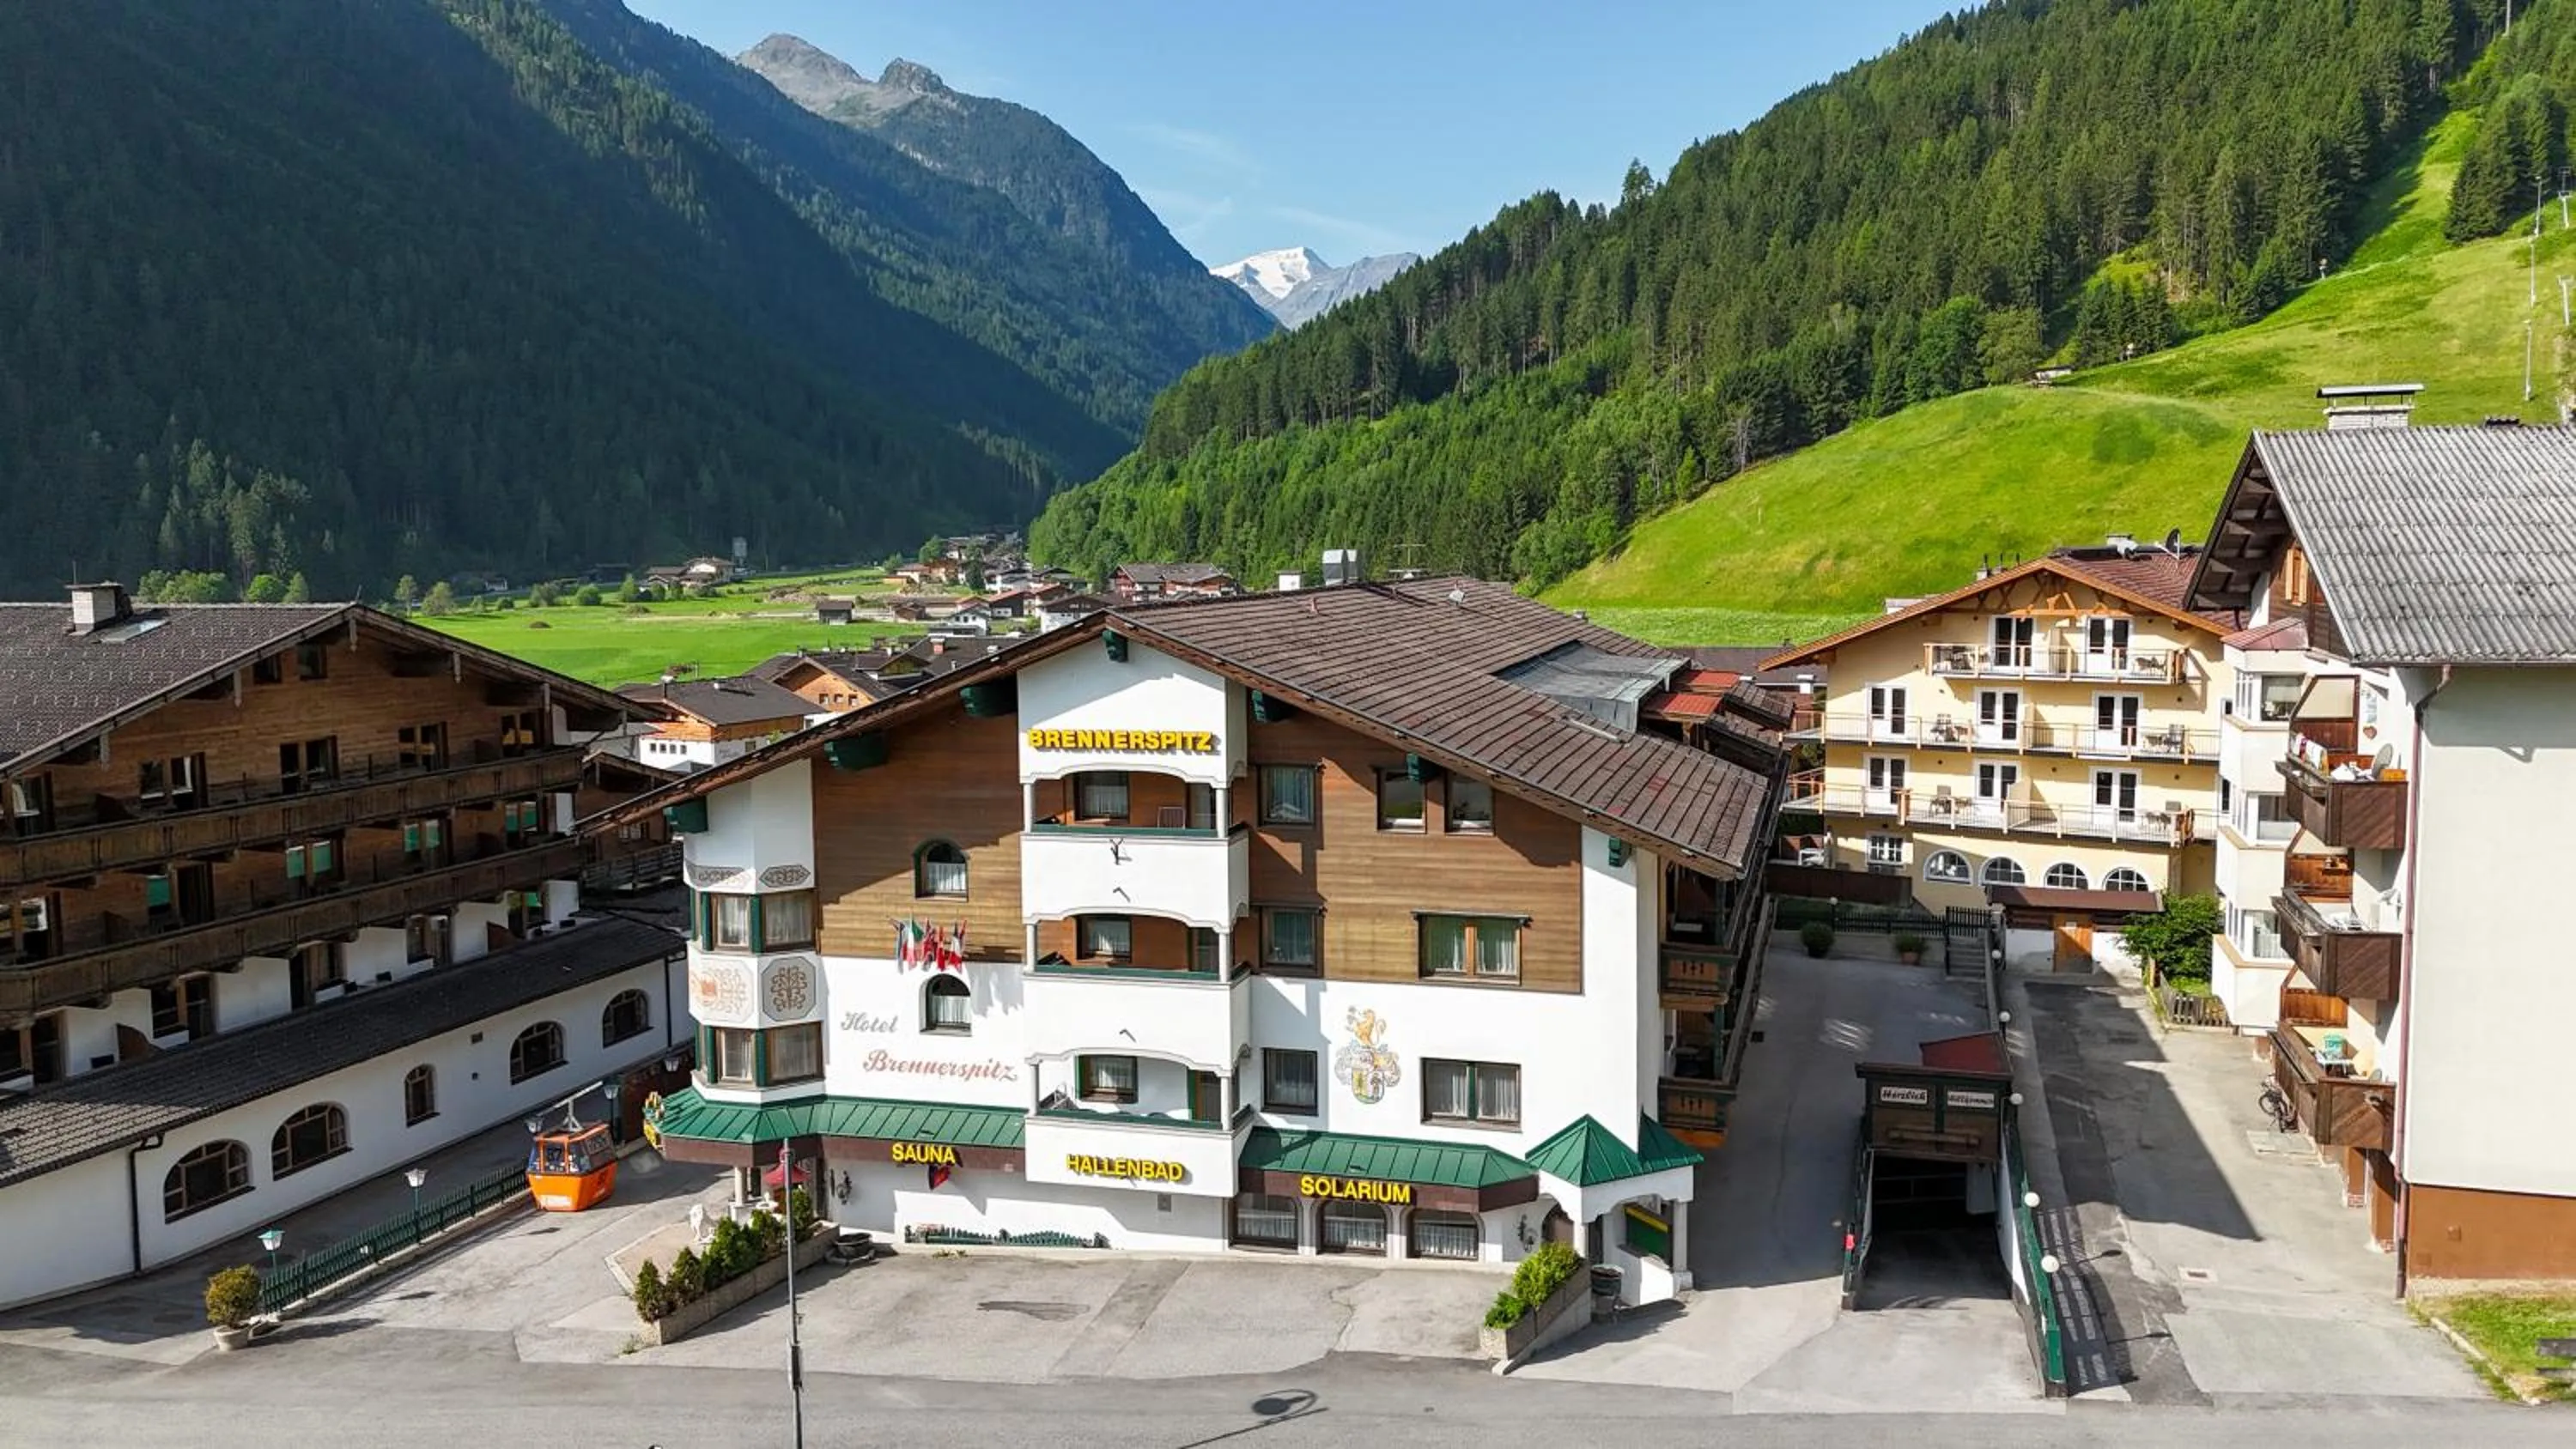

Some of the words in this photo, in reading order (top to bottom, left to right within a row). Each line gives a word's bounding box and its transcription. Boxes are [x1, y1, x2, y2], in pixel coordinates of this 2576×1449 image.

[1027, 728, 1212, 751] BRENNERSPITZ
[841, 1011, 899, 1033] Hotel
[863, 1049, 1018, 1082] Brennerspitz
[891, 1143, 957, 1165] SAUNA
[1066, 1154, 1183, 1181] HALLENBAD
[1300, 1175, 1411, 1203] SOLARIUM
